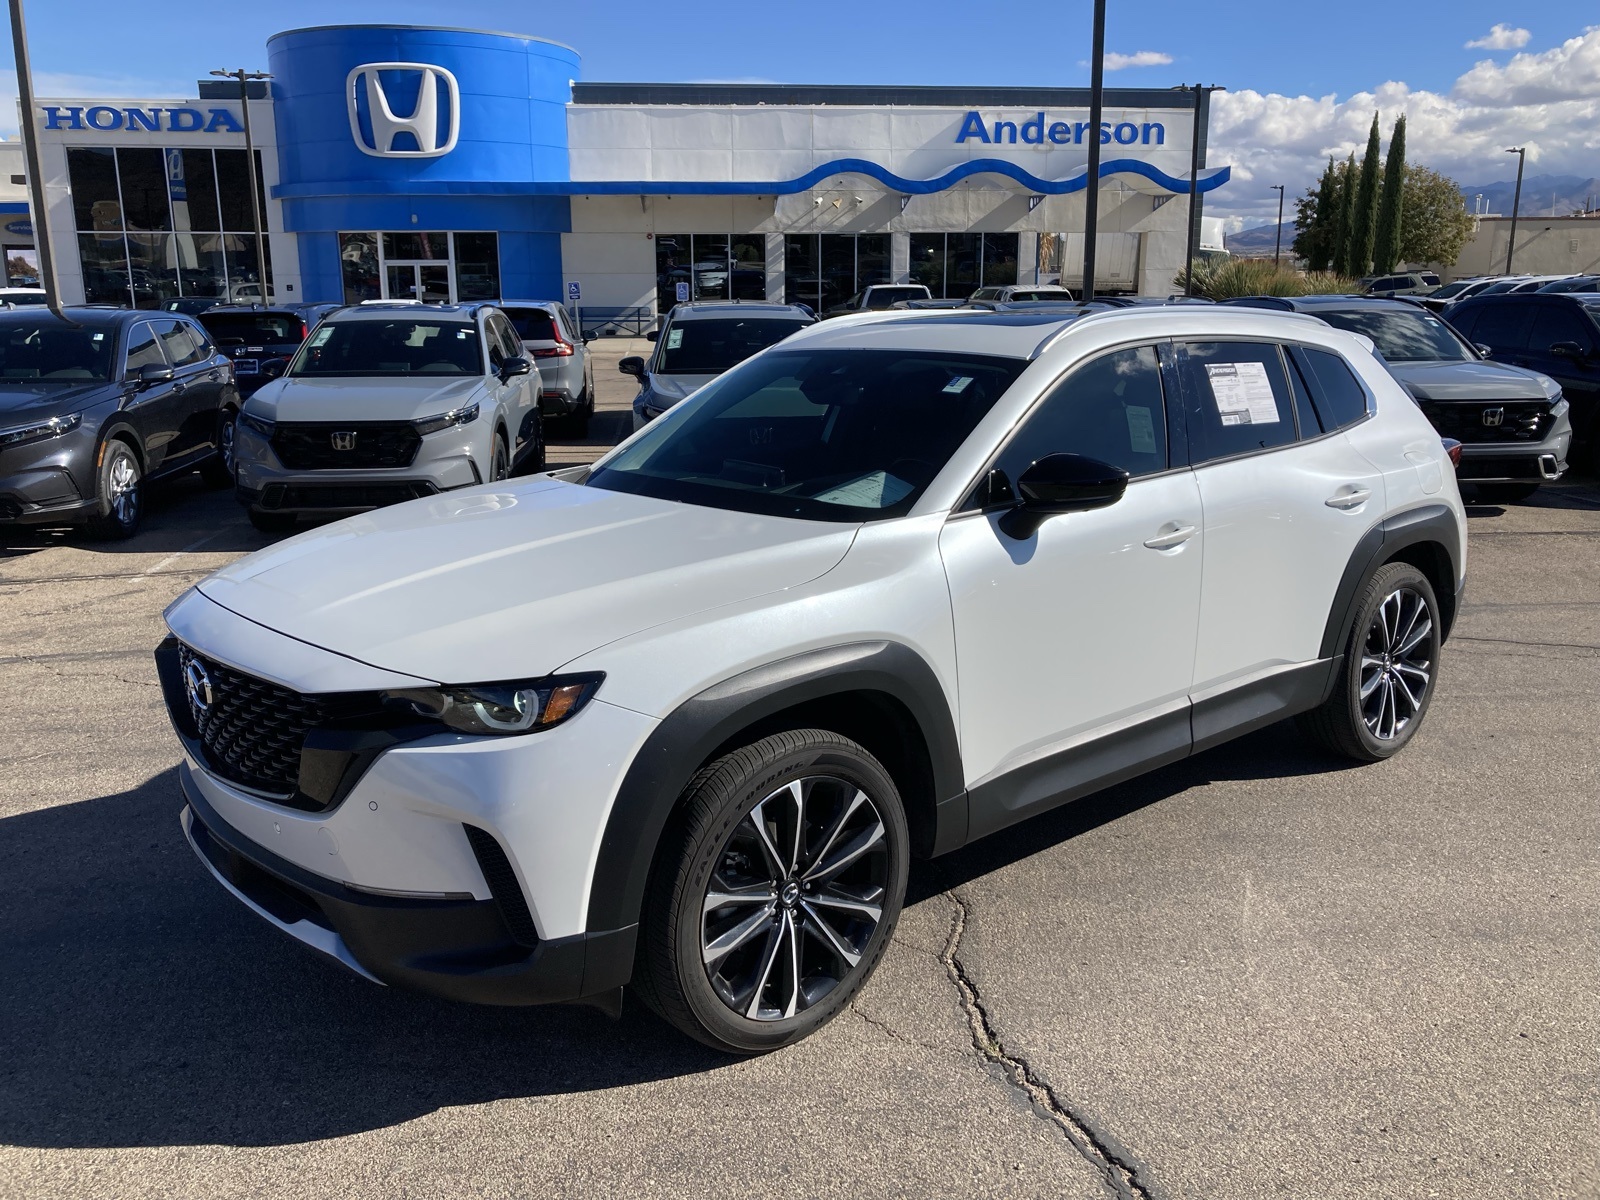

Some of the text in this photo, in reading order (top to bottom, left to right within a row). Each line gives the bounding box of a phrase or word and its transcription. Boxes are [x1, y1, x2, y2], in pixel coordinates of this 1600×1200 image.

[42, 106, 245, 133] HONDA
[955, 111, 1165, 145] Anderson
[694, 760, 805, 888] EAGLE TOURING
